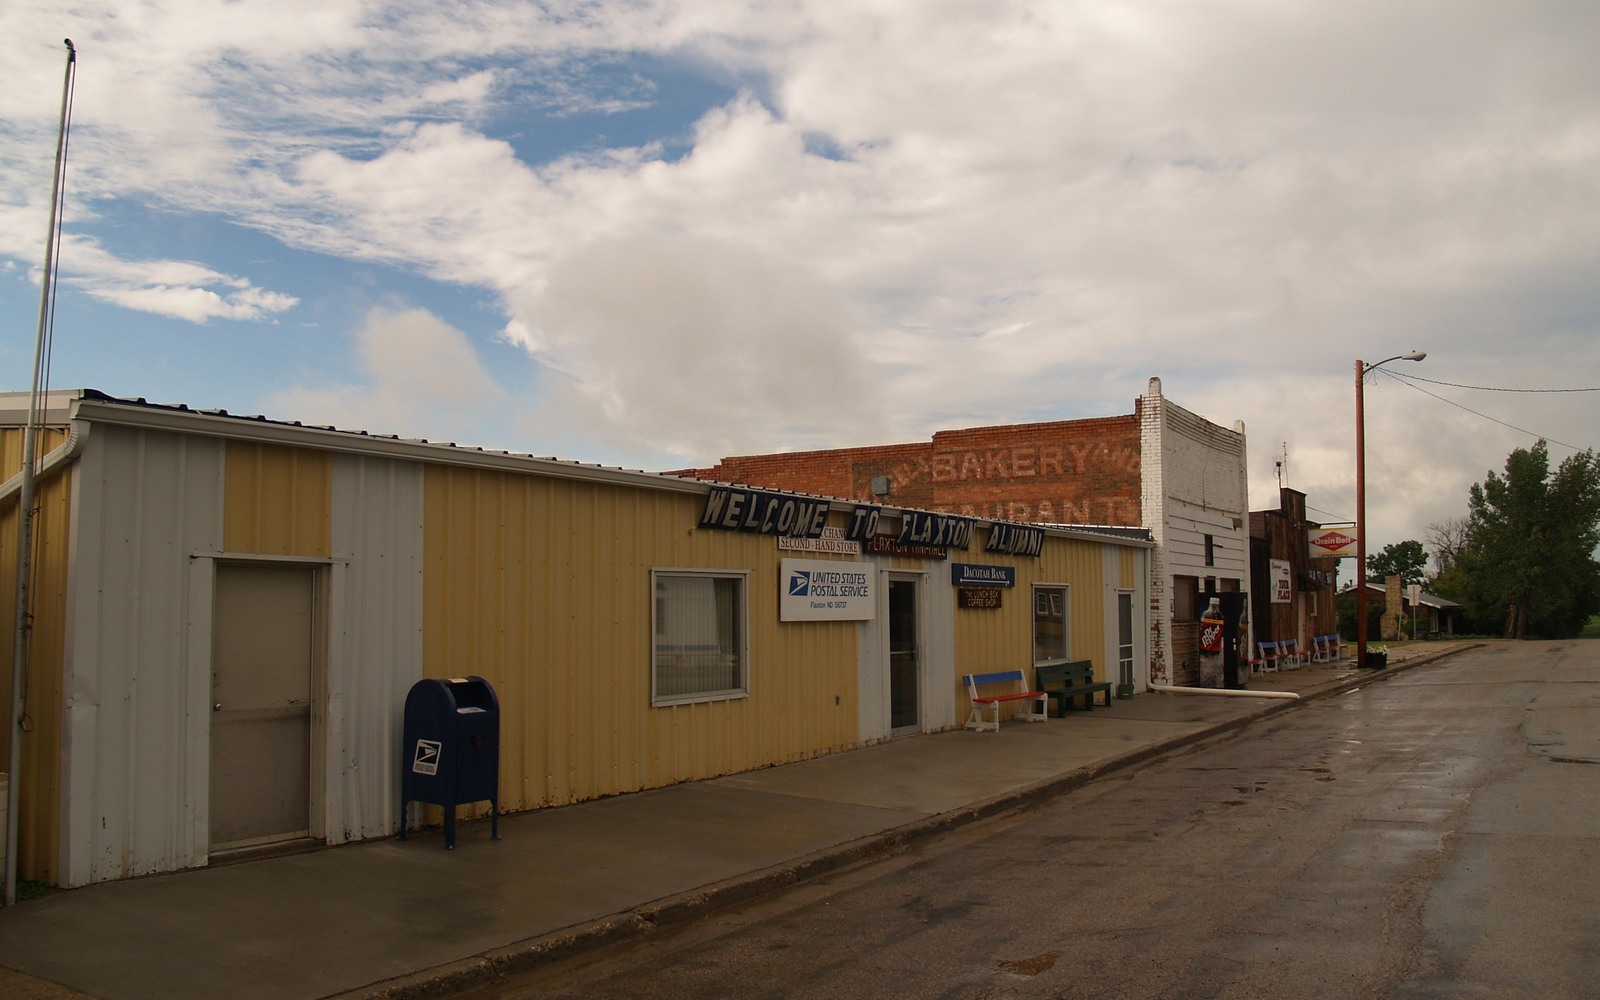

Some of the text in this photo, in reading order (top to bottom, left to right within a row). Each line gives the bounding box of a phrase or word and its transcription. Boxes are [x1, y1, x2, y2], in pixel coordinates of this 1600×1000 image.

[932, 443, 1093, 483] BAKERY
[702, 489, 1043, 556] WELCOME TO FLAXTON ALUMNI
[781, 537, 811, 549] SECOND
[815, 540, 836, 551] HAND
[837, 541, 858, 553] STORE
[1314, 536, 1351, 545] Grain Belt
[812, 572, 866, 585] UNITED STATES
[811, 585, 868, 597] POSTAL SERVICE
[1201, 624, 1221, 648] Pepper
[1204, 626, 1213, 636] Dr
